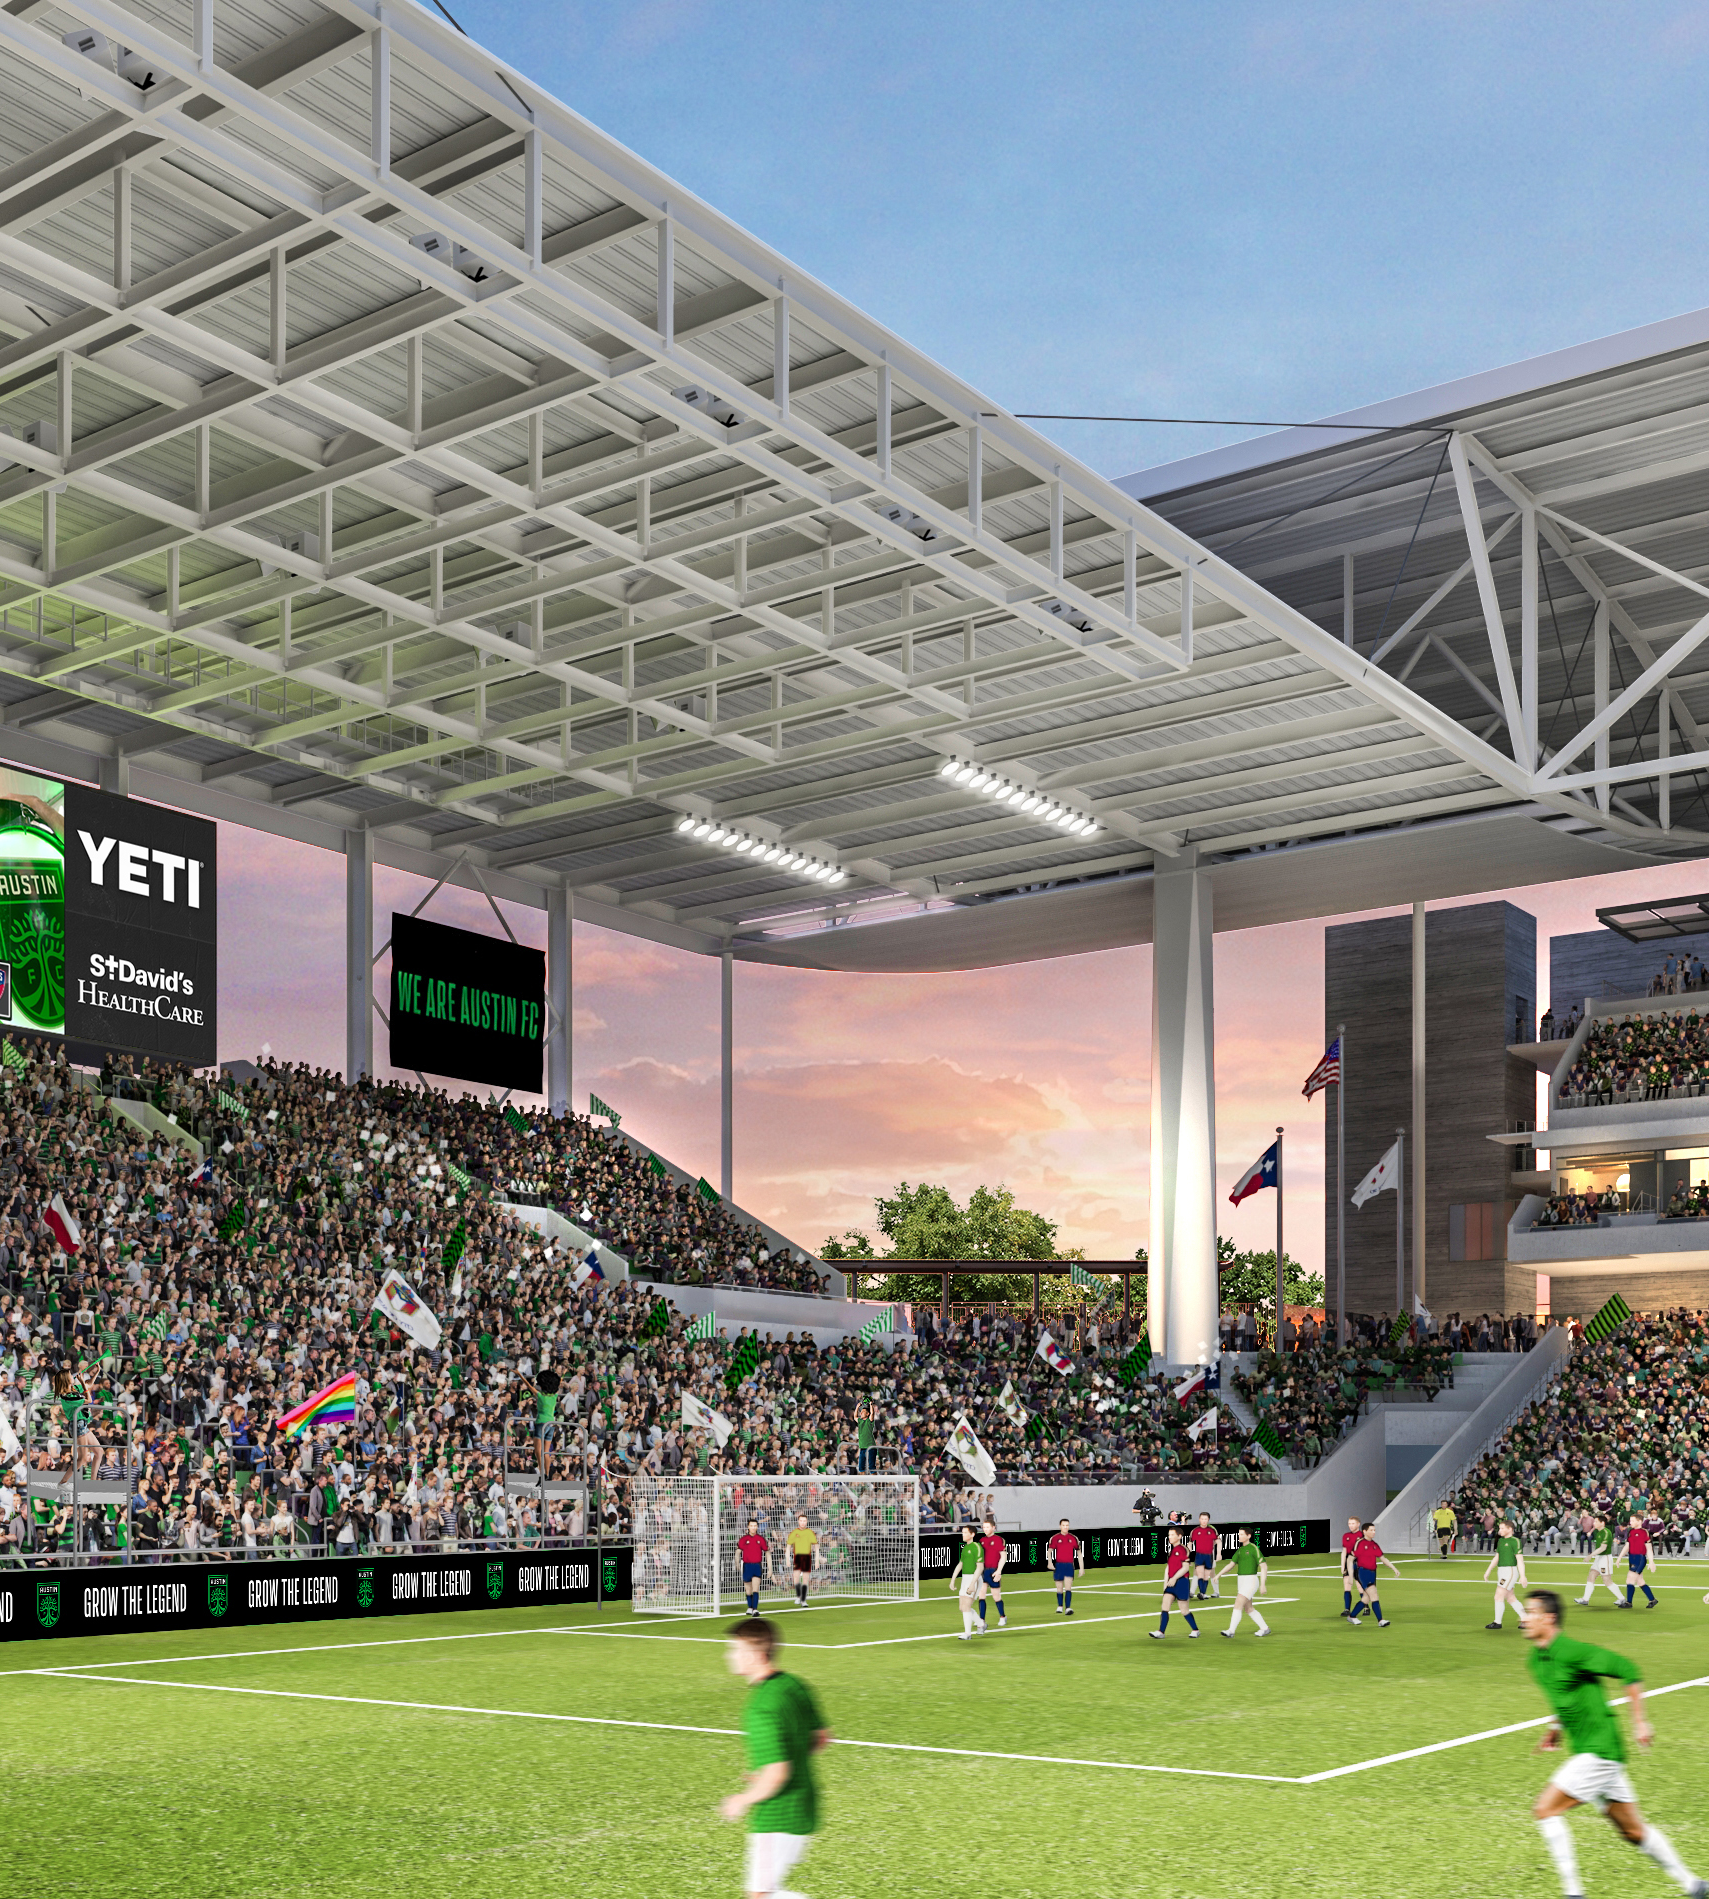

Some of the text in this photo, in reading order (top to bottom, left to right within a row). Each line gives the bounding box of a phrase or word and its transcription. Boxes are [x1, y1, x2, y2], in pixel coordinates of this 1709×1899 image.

[77, 829, 200, 909] YETI
[398, 970, 539, 1040] WE ARE AUSTIN FC
[921, 1548, 930, 1567] THE
[249, 1577, 337, 1608] GROW THE LEGEND
[393, 1570, 470, 1599] GROW THE LEGEND
[519, 1565, 588, 1591] GROW THE LEGEND
[85, 1584, 186, 1617] GROW THE LEGEND
